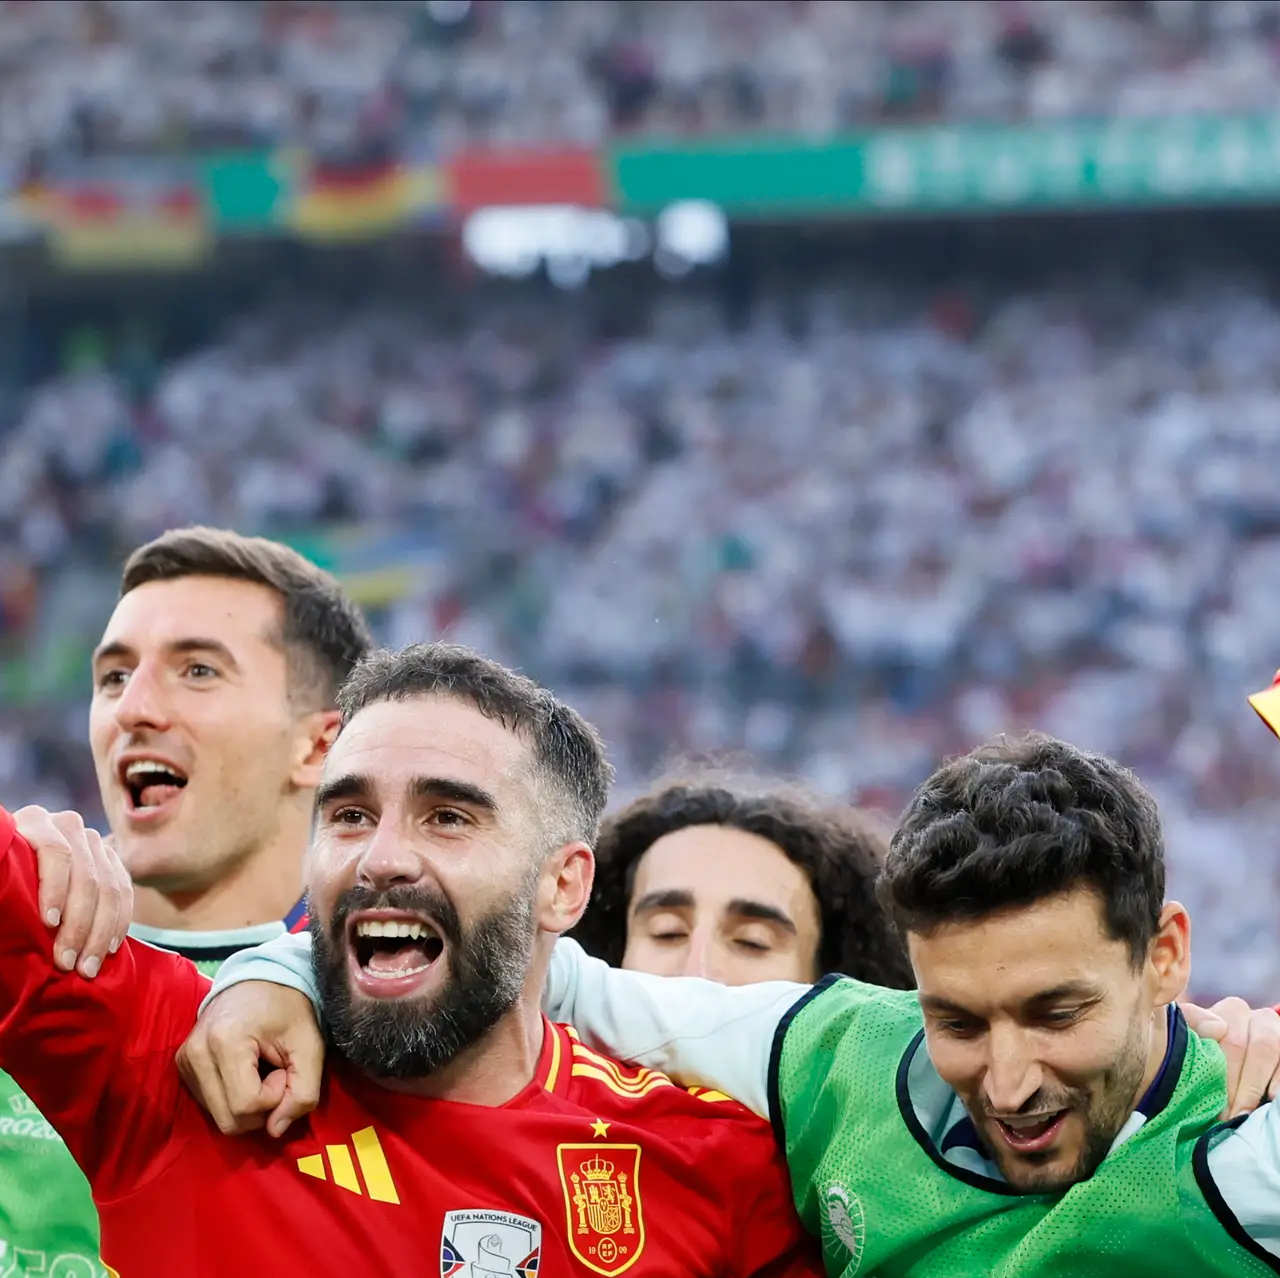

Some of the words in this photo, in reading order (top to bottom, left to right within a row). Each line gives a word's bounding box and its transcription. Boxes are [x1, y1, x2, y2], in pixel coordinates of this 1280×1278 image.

[451, 1213, 471, 1222] UEFA
[473, 1213, 507, 1222] NATIONS
[508, 1217, 537, 1232] LEAGUE
